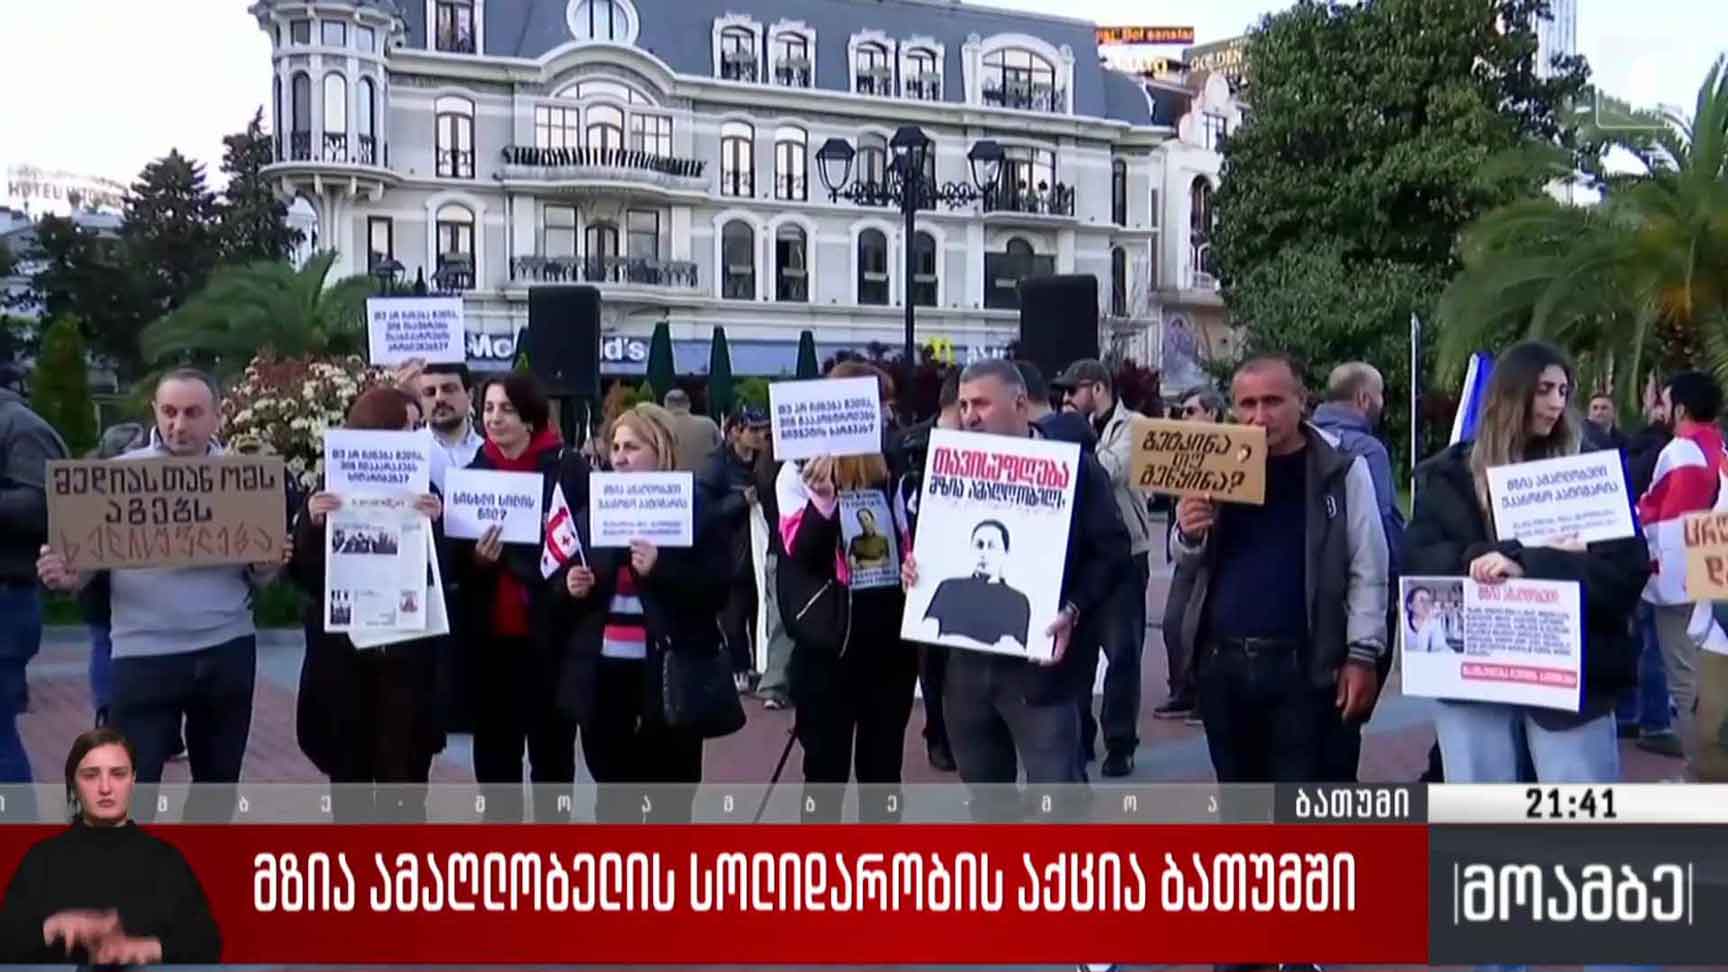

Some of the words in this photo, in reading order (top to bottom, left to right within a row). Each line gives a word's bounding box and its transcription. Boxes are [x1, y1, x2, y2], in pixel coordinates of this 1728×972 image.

[54, 465, 213, 495] მედიასთან
[221, 465, 275, 493] ომს
[933, 447, 1070, 490] თავისუფლება
[929, 475, 965, 499] მზია
[105, 498, 213, 525] აგებს
